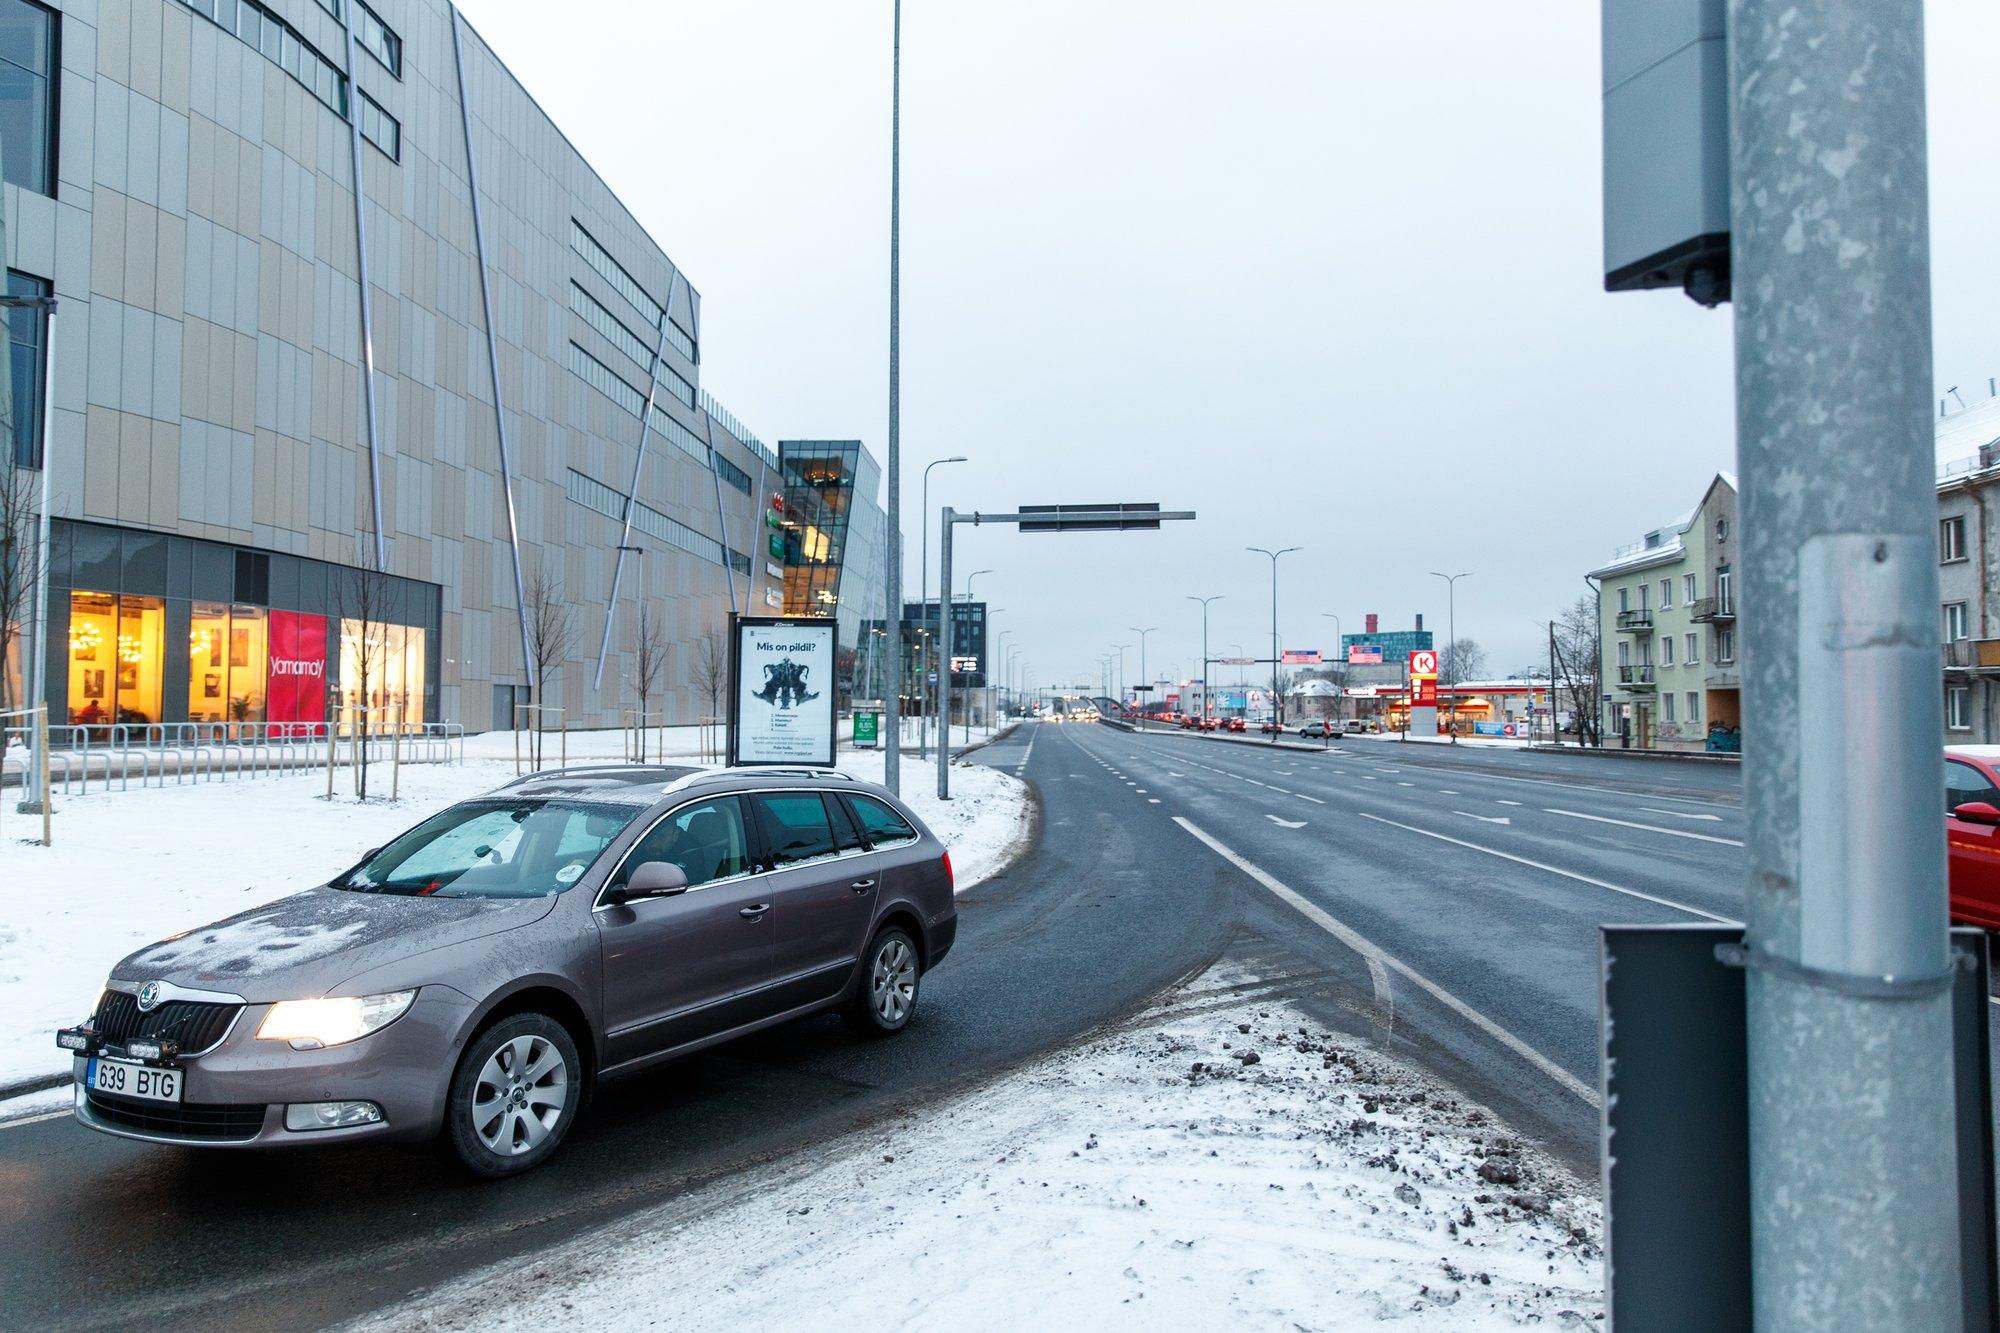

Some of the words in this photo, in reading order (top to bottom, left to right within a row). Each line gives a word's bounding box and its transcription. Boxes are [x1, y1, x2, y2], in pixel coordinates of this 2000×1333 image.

[757, 642, 773, 651] Mis
[789, 643, 816, 653] pildil?
[270, 656, 325, 679] Yamamay
[1419, 657, 1431, 672] K
[99, 1064, 126, 1091] 639
[137, 1069, 174, 1098] BTG
